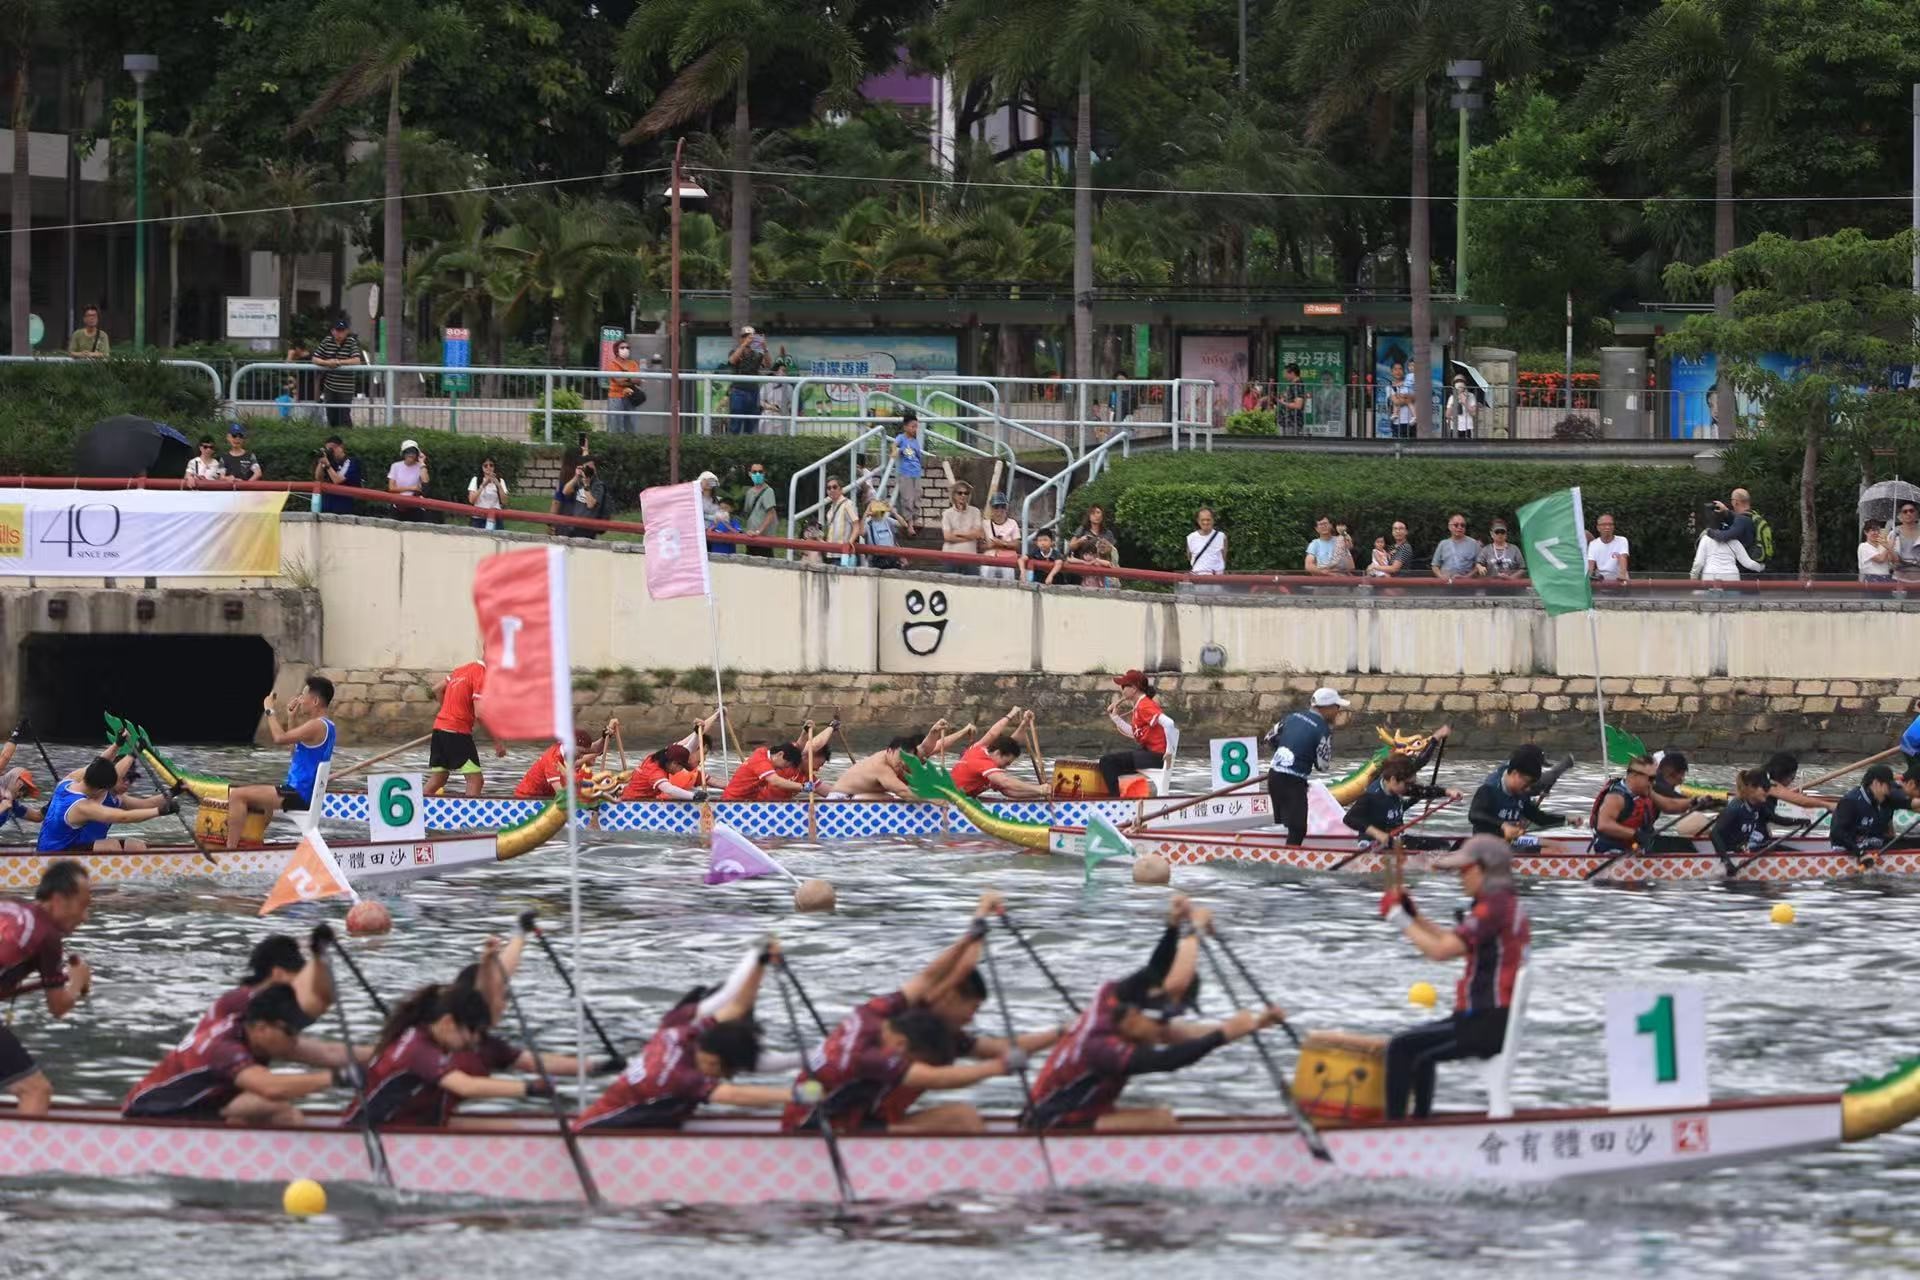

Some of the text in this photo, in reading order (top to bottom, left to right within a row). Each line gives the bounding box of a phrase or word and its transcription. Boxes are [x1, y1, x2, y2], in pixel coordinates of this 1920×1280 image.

[447, 328, 468, 336] 804
[603, 328, 622, 336] 803
[40, 504, 120, 557] 40
[657, 527, 681, 560] 8
[1221, 740, 1251, 784] 8
[379, 776, 414, 827] 6
[1635, 994, 1678, 1084] 1
